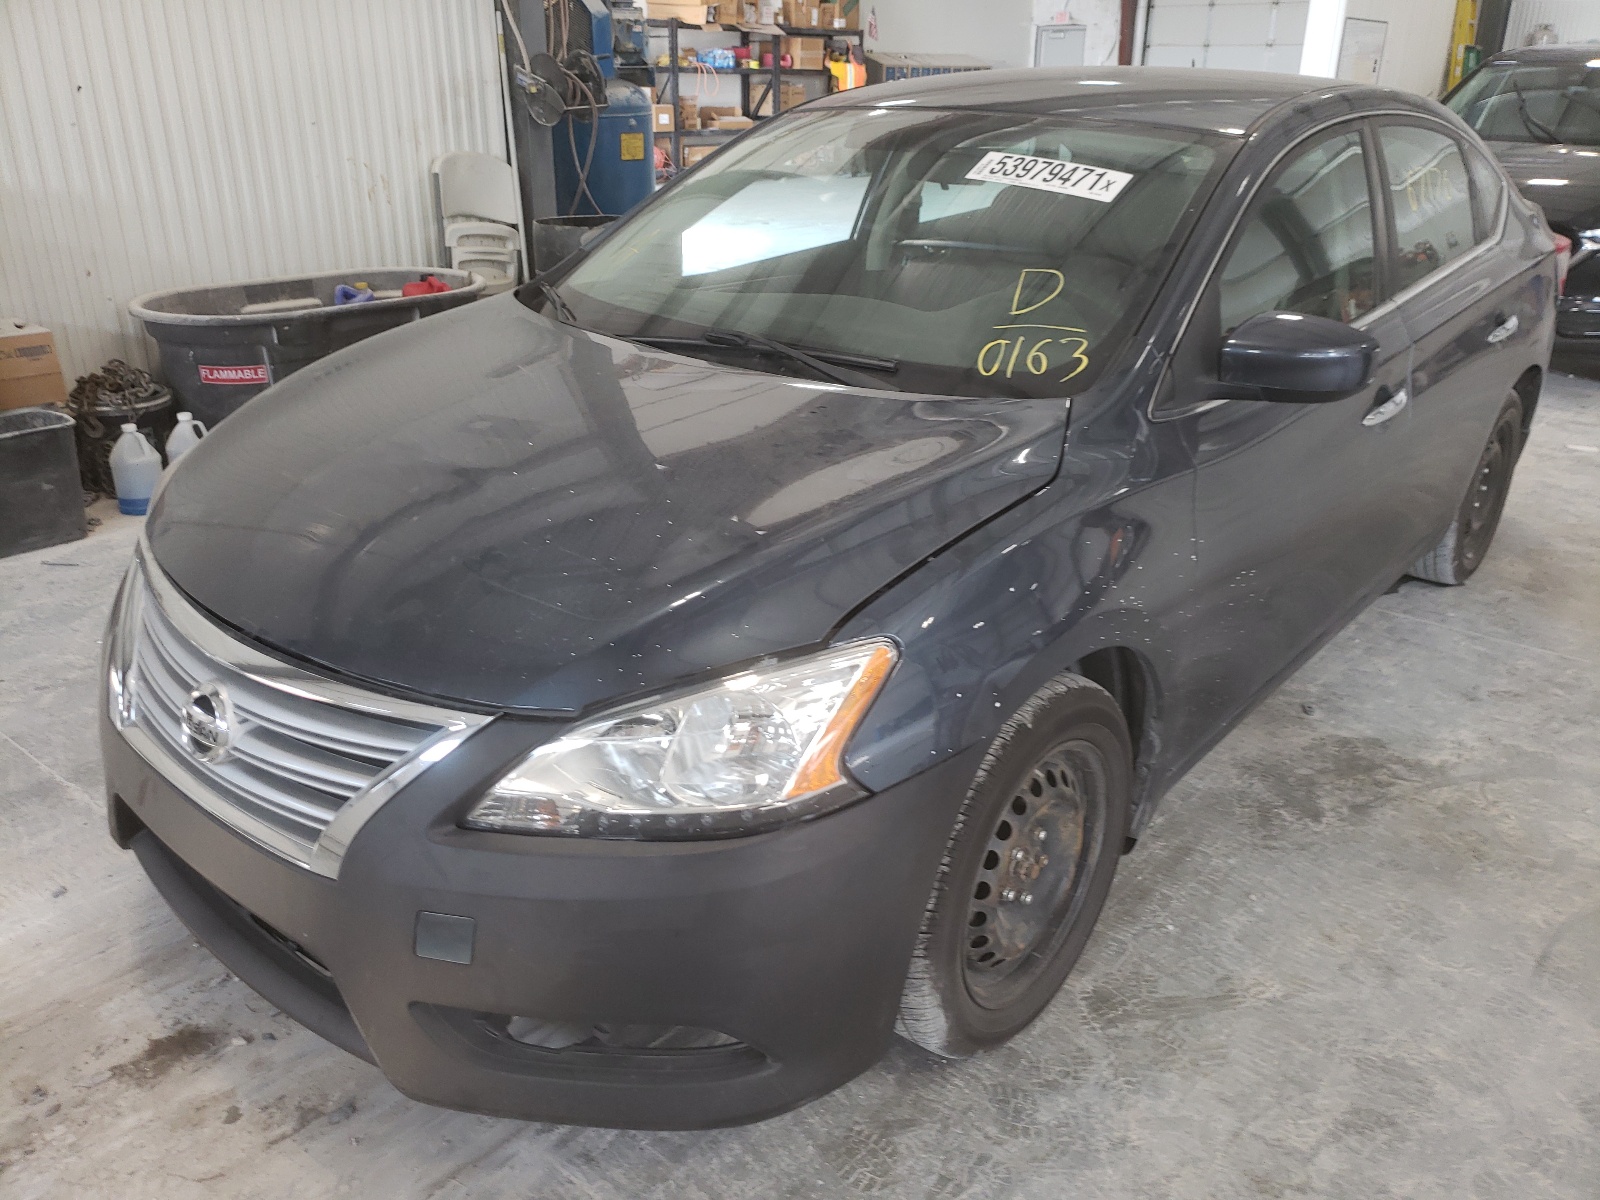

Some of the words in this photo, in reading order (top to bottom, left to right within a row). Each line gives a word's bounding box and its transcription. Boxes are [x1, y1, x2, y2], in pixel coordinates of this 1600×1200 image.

[989, 155, 1107, 190] 53979471
[1009, 268, 1064, 315] D
[200, 368, 267, 380] FLAMMABLE
[977, 336, 1089, 383] 0163
